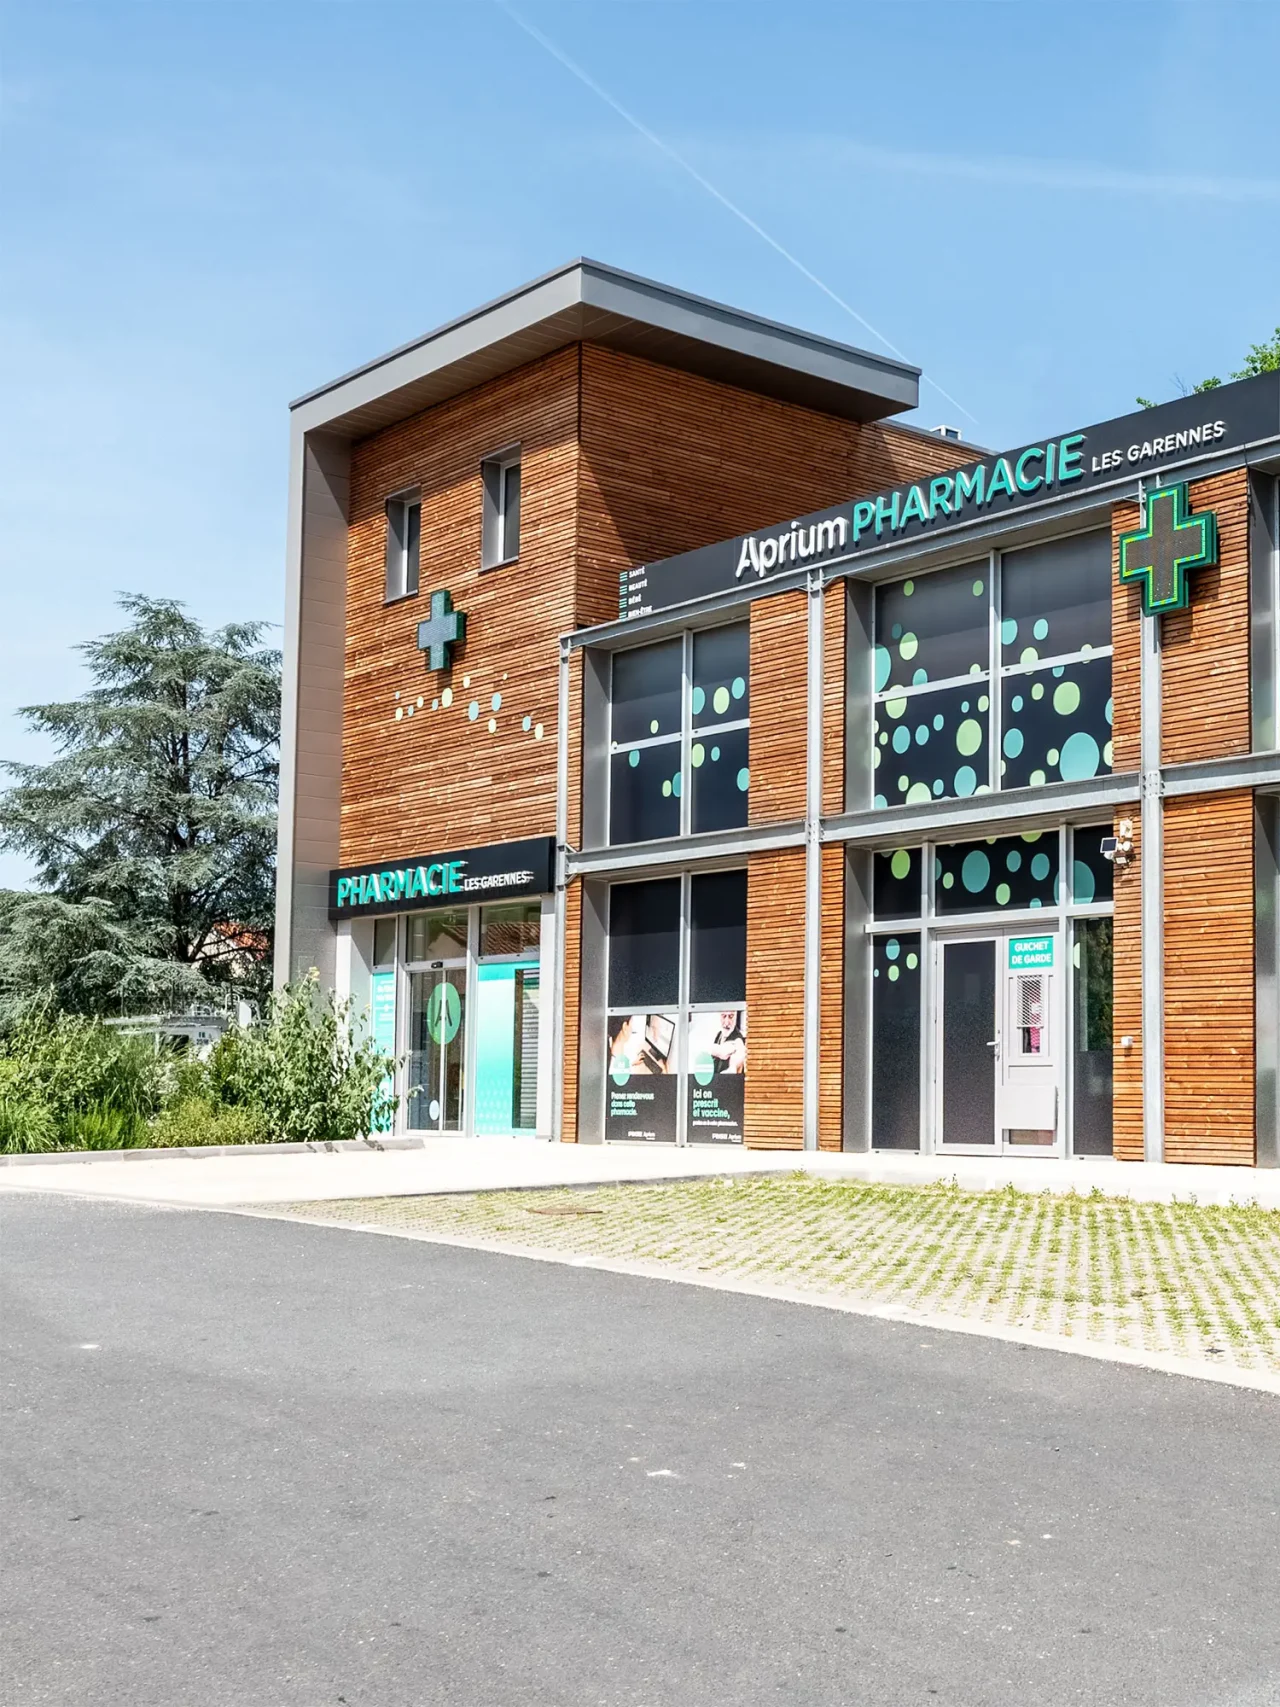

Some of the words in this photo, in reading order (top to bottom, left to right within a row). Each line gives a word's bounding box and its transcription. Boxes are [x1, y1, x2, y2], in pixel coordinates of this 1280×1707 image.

[735, 517, 848, 578] Aprium
[852, 434, 1088, 542] PHARMACIE
[1091, 452, 1122, 473] LES
[1127, 421, 1226, 462] GARENNES
[337, 860, 468, 907] PHARMACIE
[464, 877, 479, 891] LES
[480, 871, 532, 888] GARENNES
[1014, 941, 1050, 952] GUICHET
[1011, 955, 1023, 965] DE
[1023, 953, 1052, 965] GARDE
[692, 1088, 702, 1099] Ici
[702, 1090, 713, 1099] on
[692, 1108, 700, 1118] et
